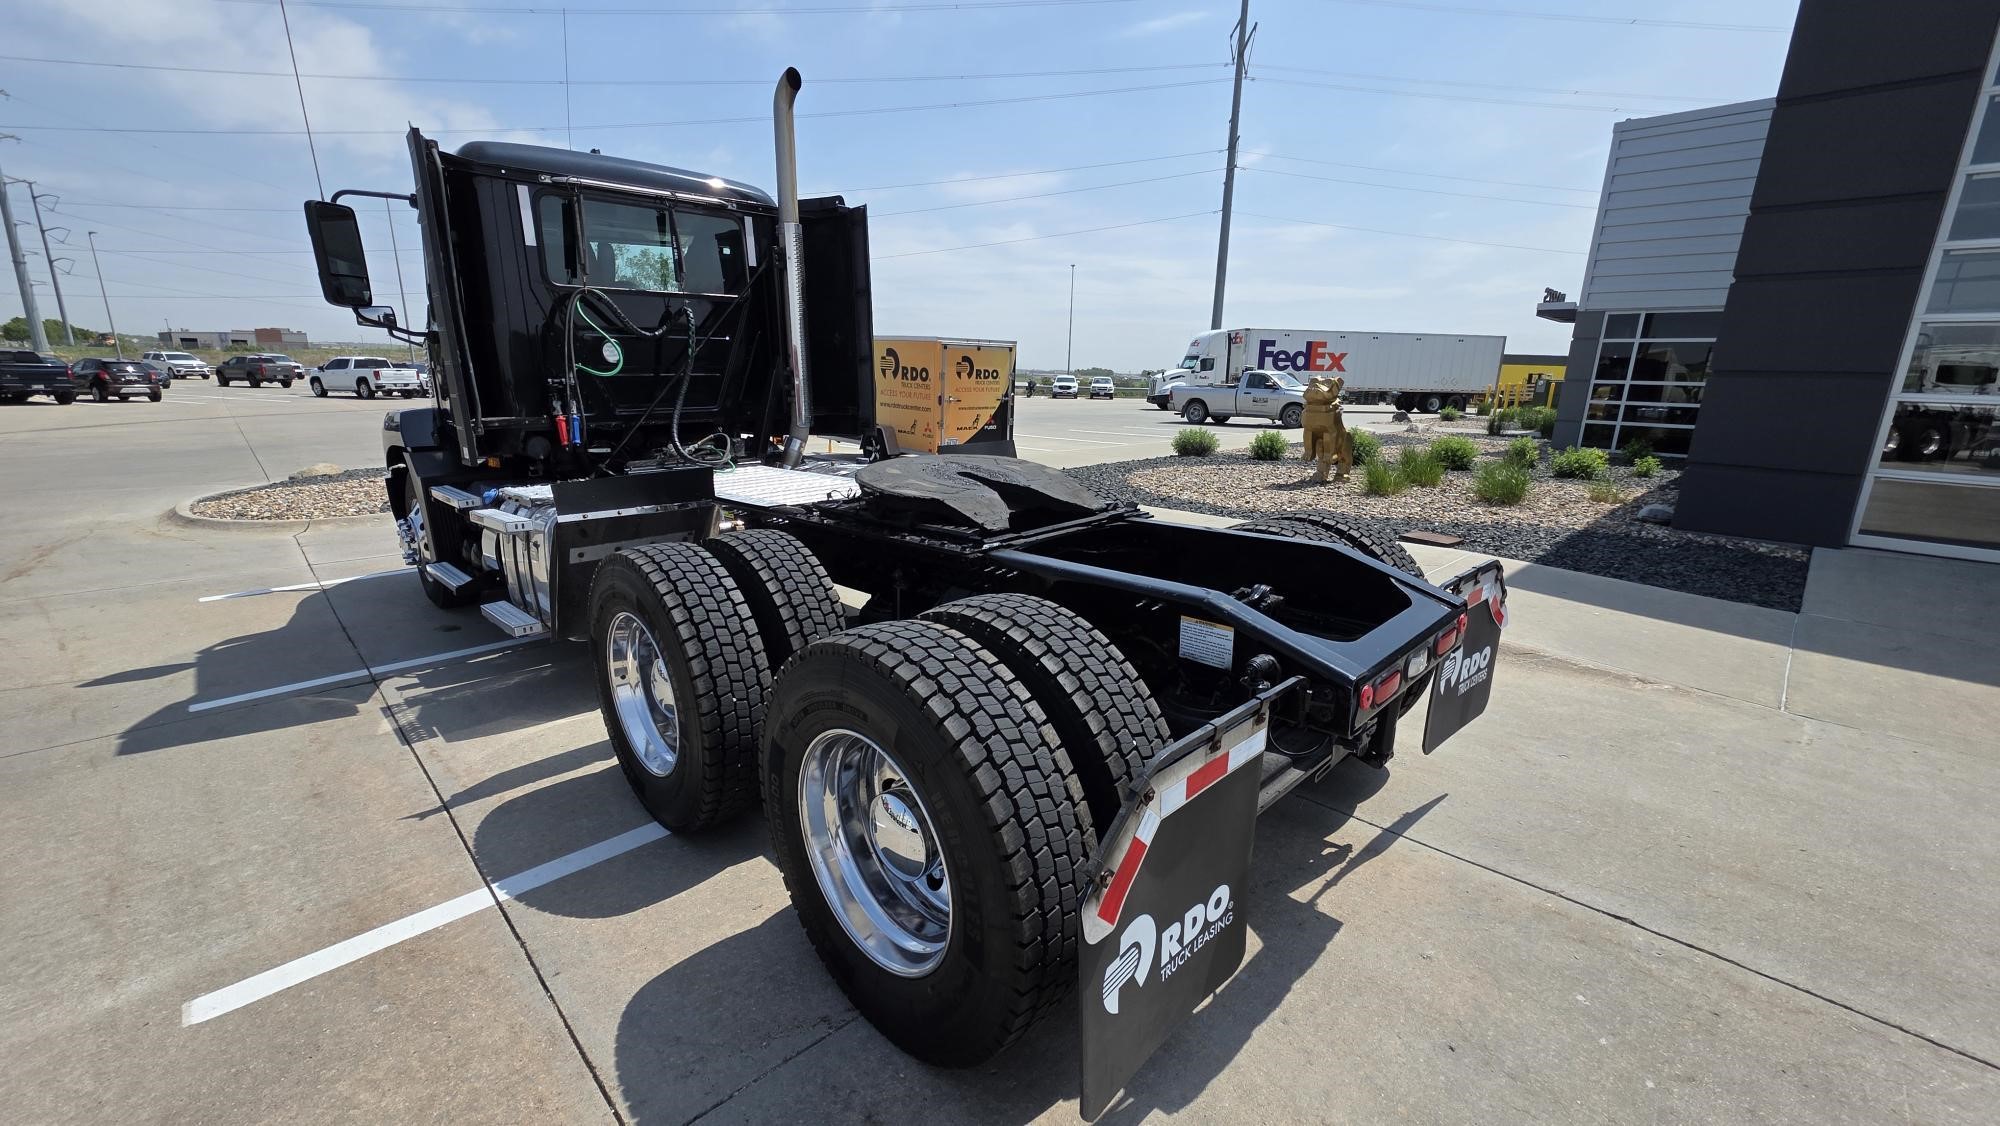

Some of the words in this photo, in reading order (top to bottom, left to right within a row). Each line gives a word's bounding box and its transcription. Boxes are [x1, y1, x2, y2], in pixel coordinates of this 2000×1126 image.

[1257, 339, 1348, 372] FedEx
[901, 366, 929, 382] RDO
[975, 369, 999, 380] RDO
[1460, 646, 1491, 683] RDO
[1160, 884, 1230, 968] RDO
[1160, 944, 1192, 982] TRUCK
[1193, 912, 1234, 953] LEASING
